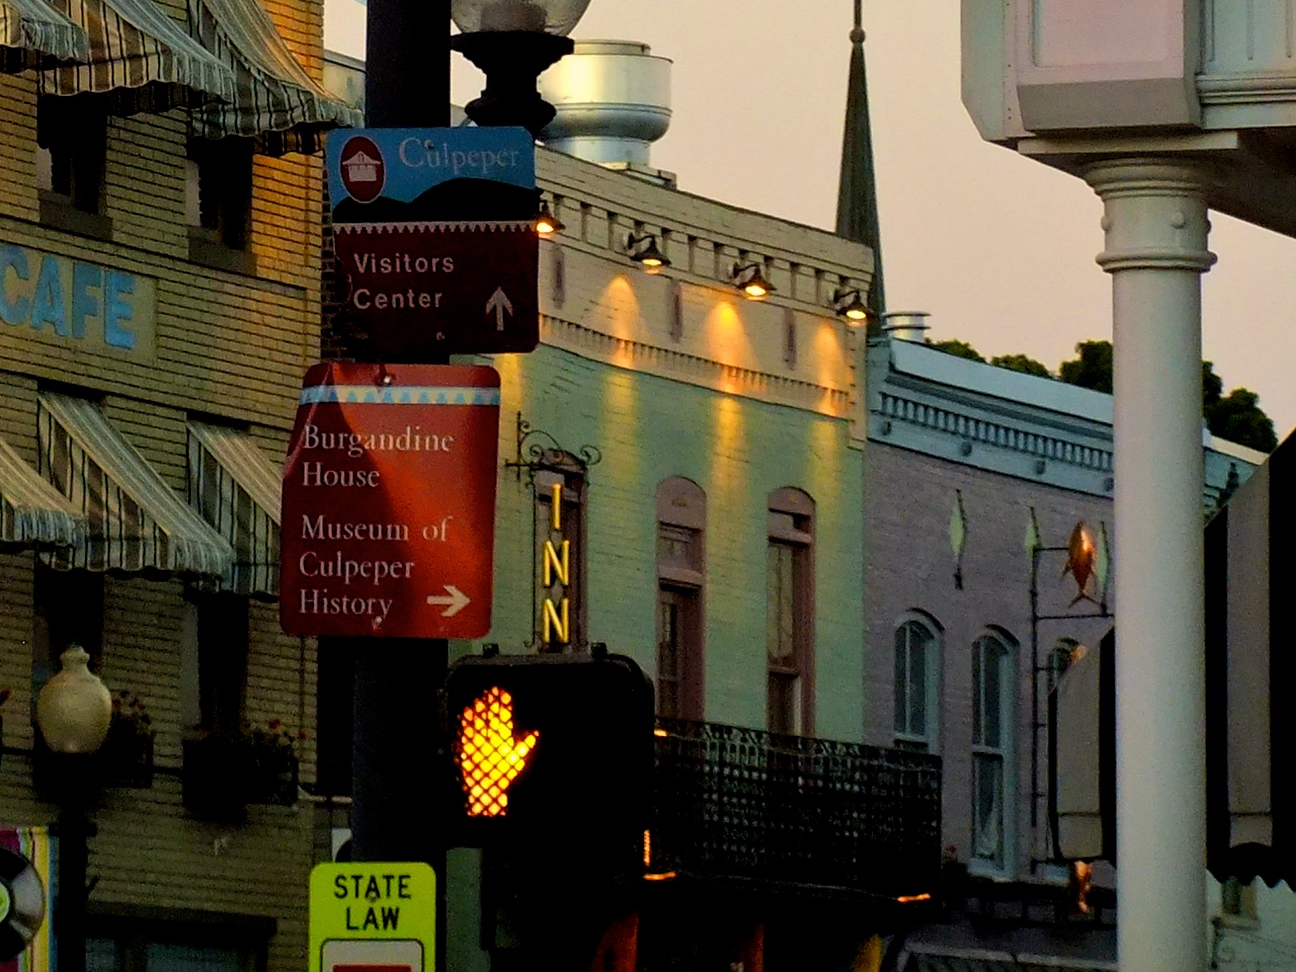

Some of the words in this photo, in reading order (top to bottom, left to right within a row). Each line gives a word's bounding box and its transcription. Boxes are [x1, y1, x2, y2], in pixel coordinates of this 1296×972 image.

[399, 136, 520, 174] Culpeper
[353, 252, 455, 275] Visitors
[353, 288, 443, 310] Center
[302, 424, 454, 458] Burgandine
[301, 460, 380, 488] House
[300, 513, 410, 542] Museum
[422, 514, 453, 542] of
[298, 550, 415, 584] Culpeper
[542, 483, 571, 644] INN
[299, 588, 393, 617] History
[334, 874, 411, 900] STATE
[345, 906, 400, 930] LAW
